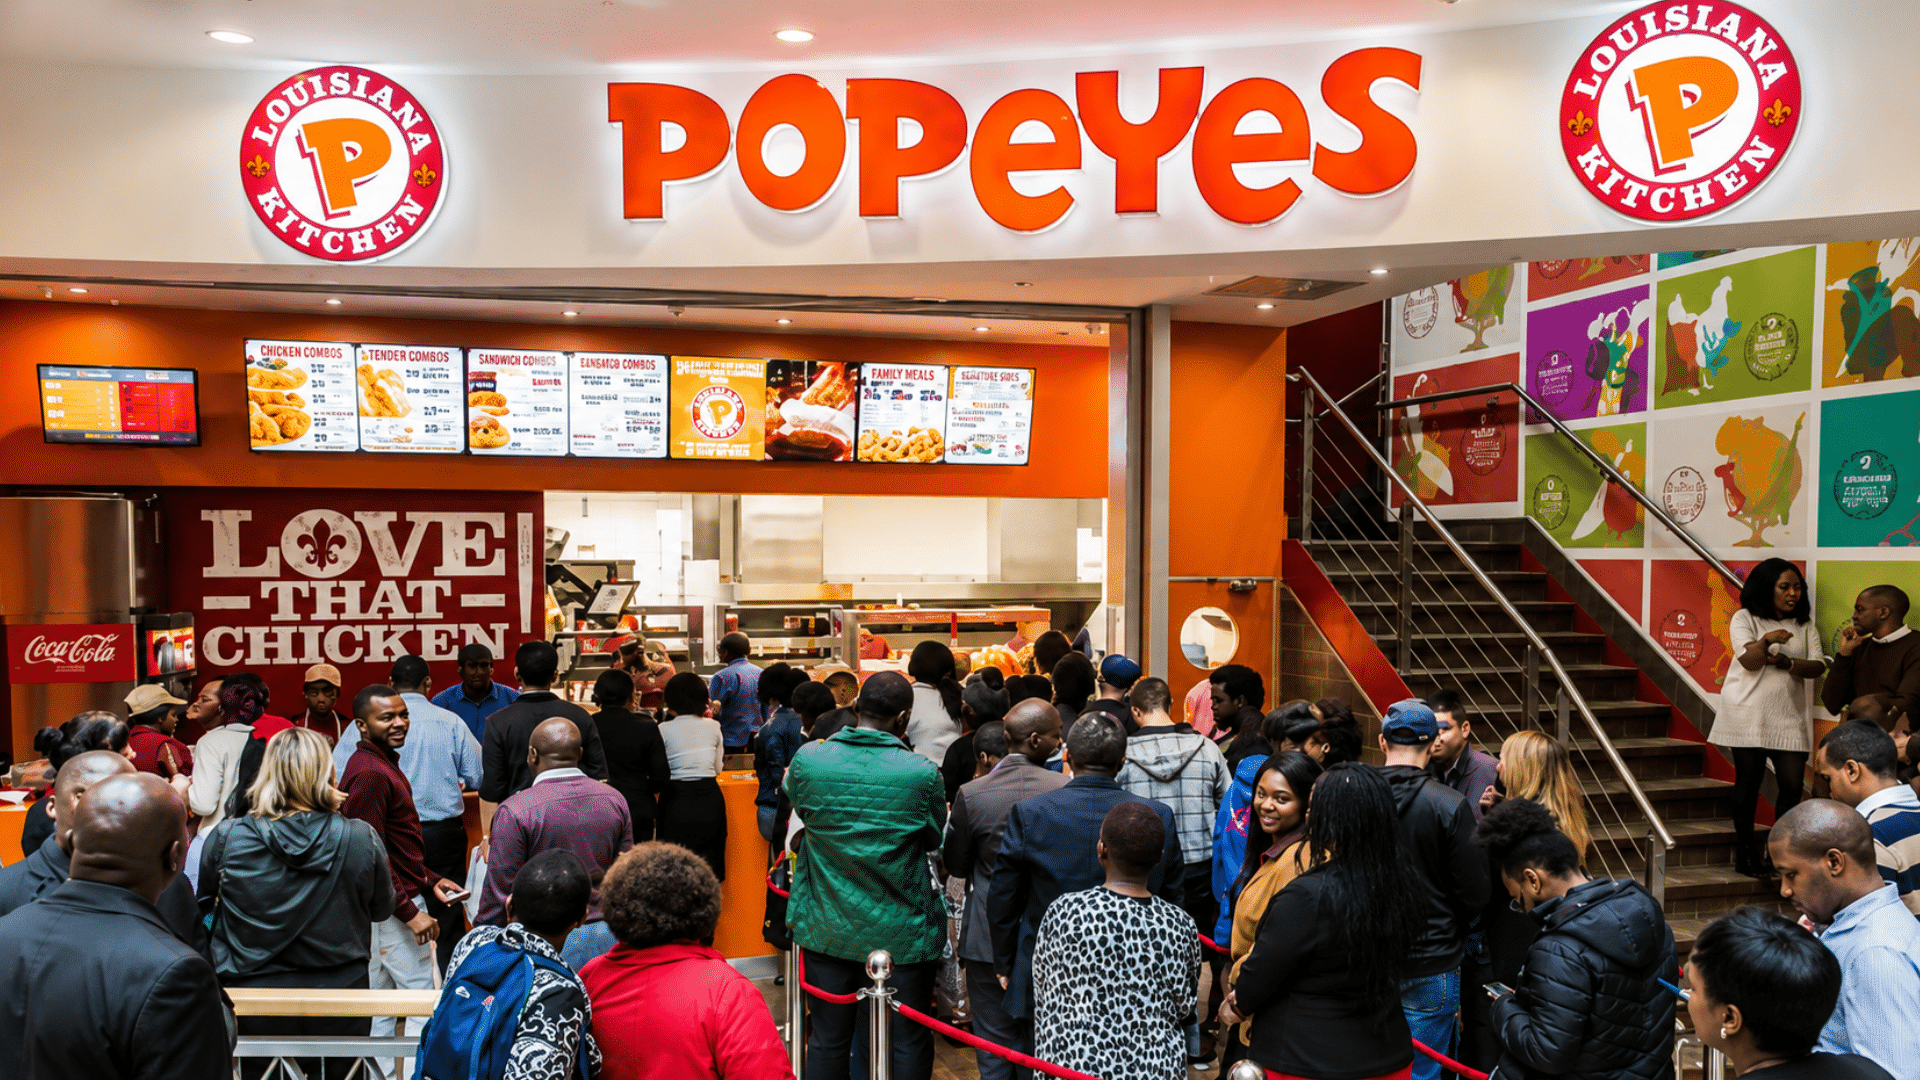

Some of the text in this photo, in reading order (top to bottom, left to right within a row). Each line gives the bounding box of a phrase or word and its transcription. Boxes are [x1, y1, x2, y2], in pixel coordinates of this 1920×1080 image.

[1573, 5, 1788, 91] LOUISIANA
[252, 72, 432, 156] LOUISIANA
[1577, 135, 1776, 213] KITCHEN
[257, 187, 424, 254] KITCHEN
[260, 344, 343, 359] CHICKEN COMBOS
[368, 349, 406, 362] TENDER
[478, 353, 520, 366] SANDWICH
[622, 358, 656, 371] COMBOS
[871, 368, 935, 381] FAMILY MEALS
[201, 508, 506, 578] LOVE
[260, 580, 452, 621] THAT
[24, 633, 119, 664] Coca-Cola
[202, 623, 510, 667] CHICKEN
